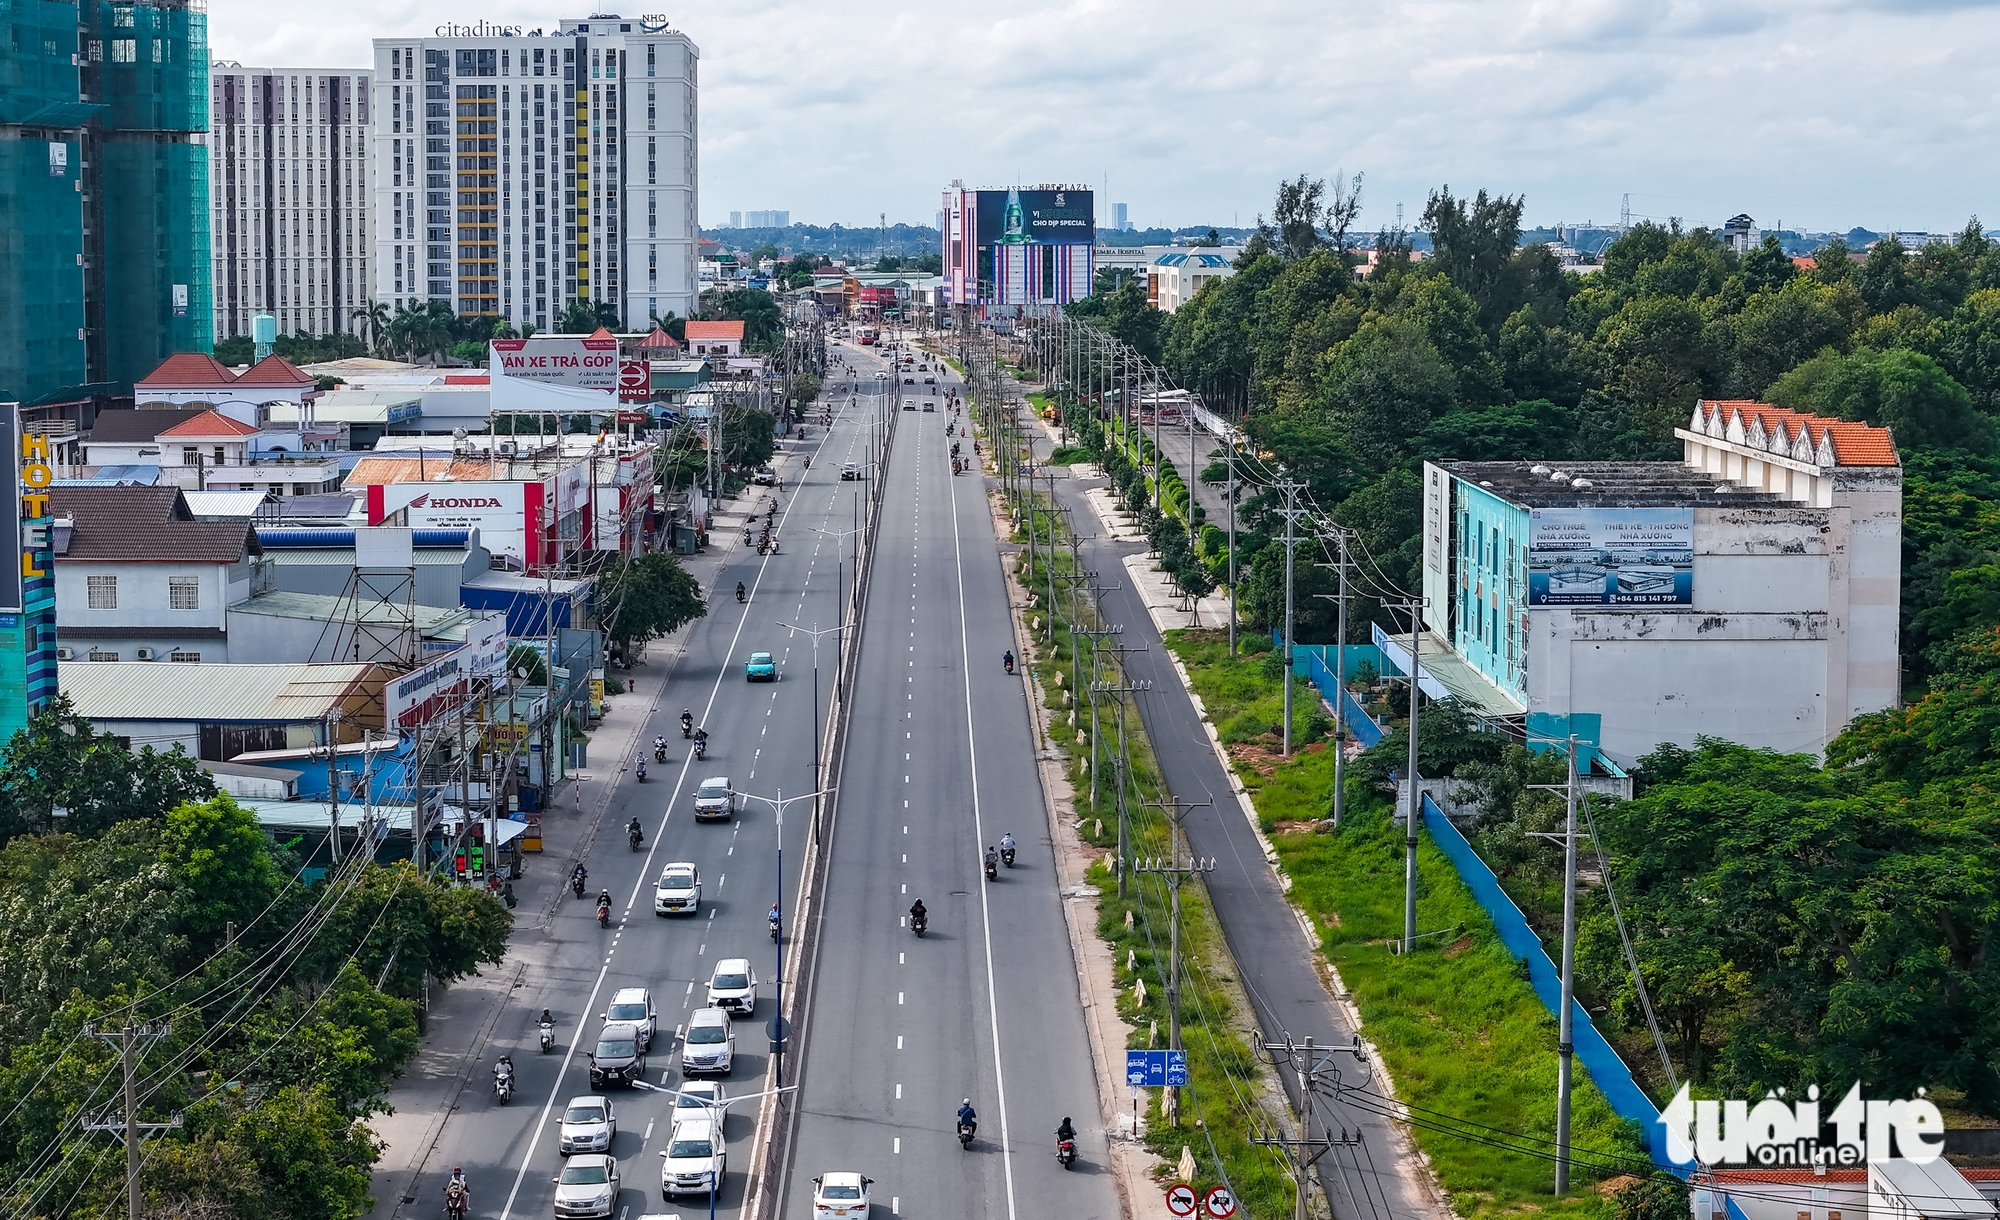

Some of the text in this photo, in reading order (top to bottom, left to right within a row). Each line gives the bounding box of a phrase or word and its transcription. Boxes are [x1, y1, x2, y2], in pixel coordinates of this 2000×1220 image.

[434, 18, 522, 38] citadines
[1058, 183, 1088, 191] PLAZA
[1040, 208, 1087, 219] SPECIAL
[1048, 219, 1060, 228] DỊP
[528, 356, 547, 368] XE
[550, 351, 580, 368] TRẢ
[583, 351, 614, 368] GÓP
[22, 433, 52, 577] HOTEL
[430, 498, 503, 508] HONDA
[1541, 521, 1586, 531] CHO THUÊ
[1664, 521, 1689, 530] CÔNG
[1620, 531, 1640, 540] NHÀ
